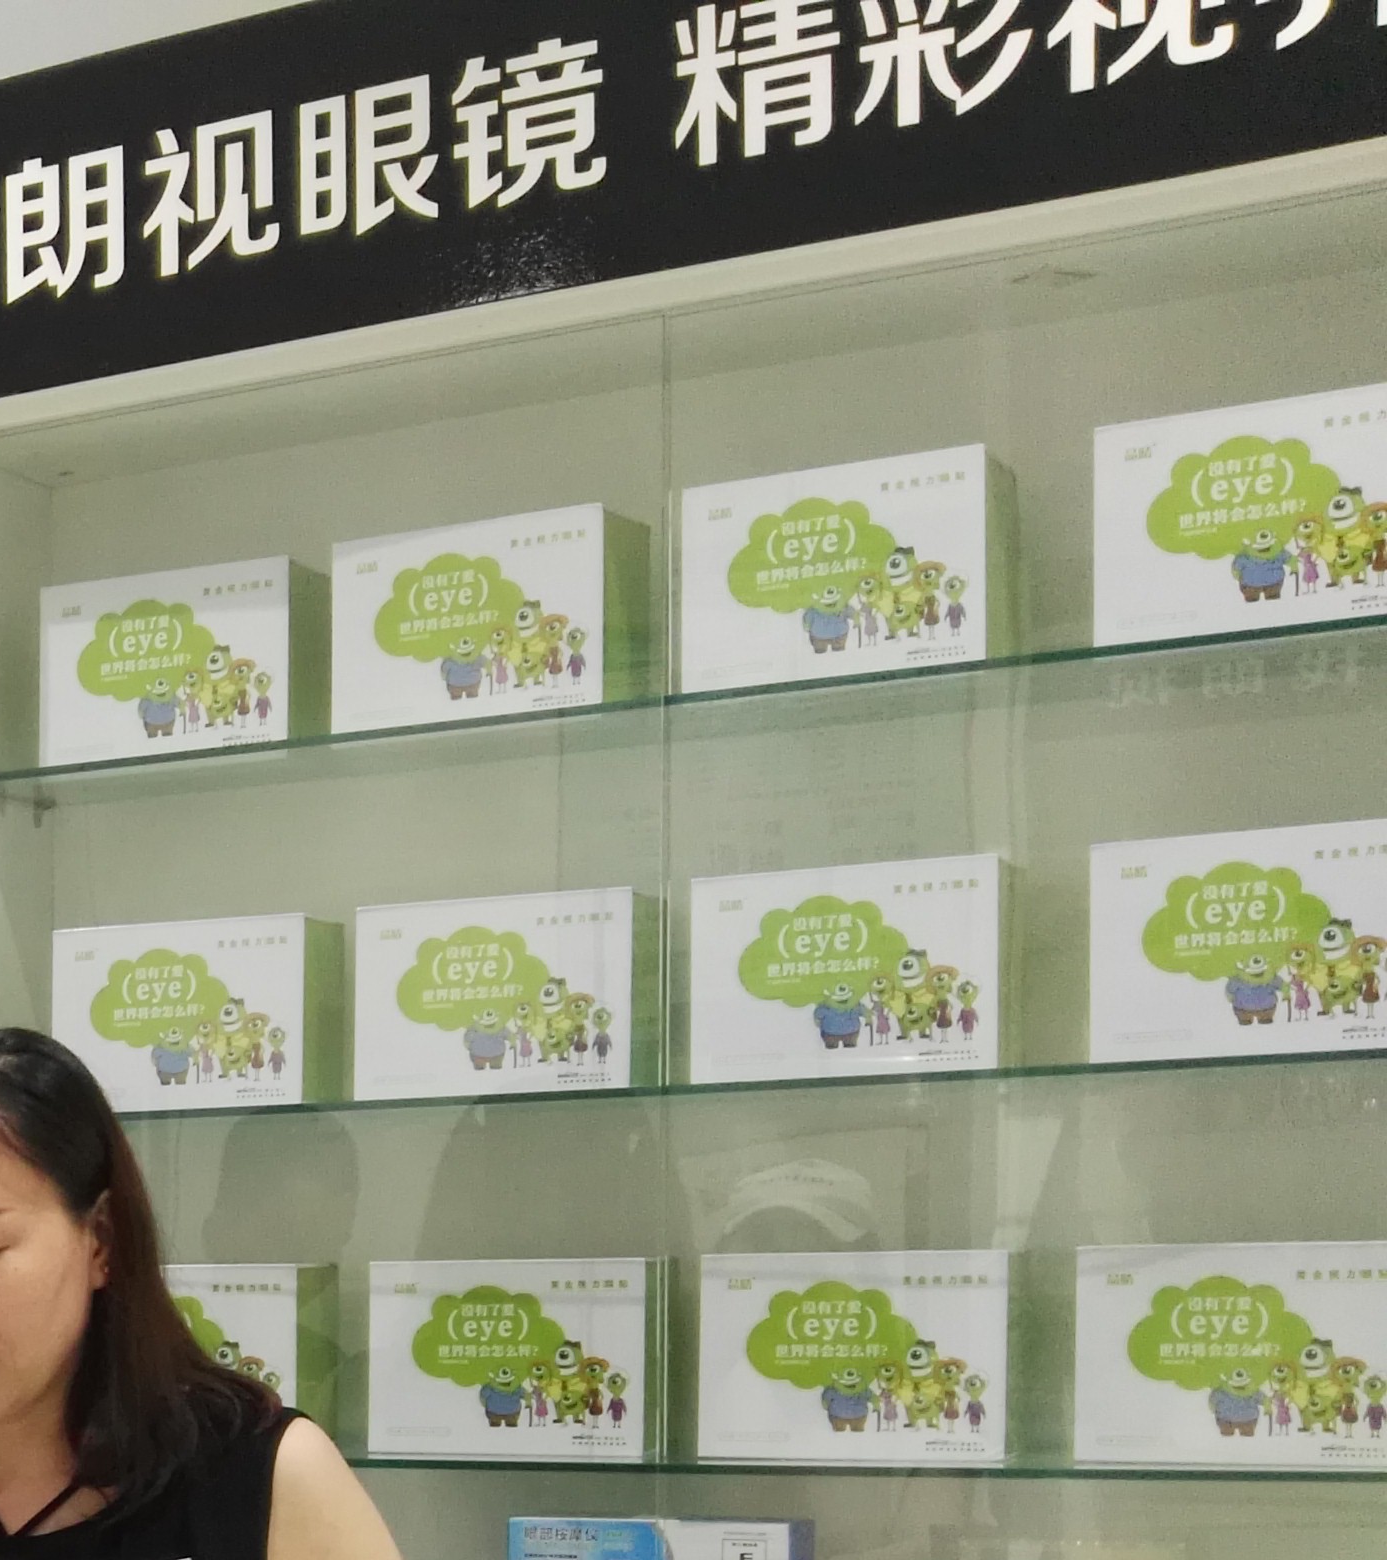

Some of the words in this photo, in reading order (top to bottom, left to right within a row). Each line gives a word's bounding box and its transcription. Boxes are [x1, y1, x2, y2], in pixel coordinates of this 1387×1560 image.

[1, 38, 606, 305] 朗视眼镜
[674, 0, 1387, 165] 精彩视
